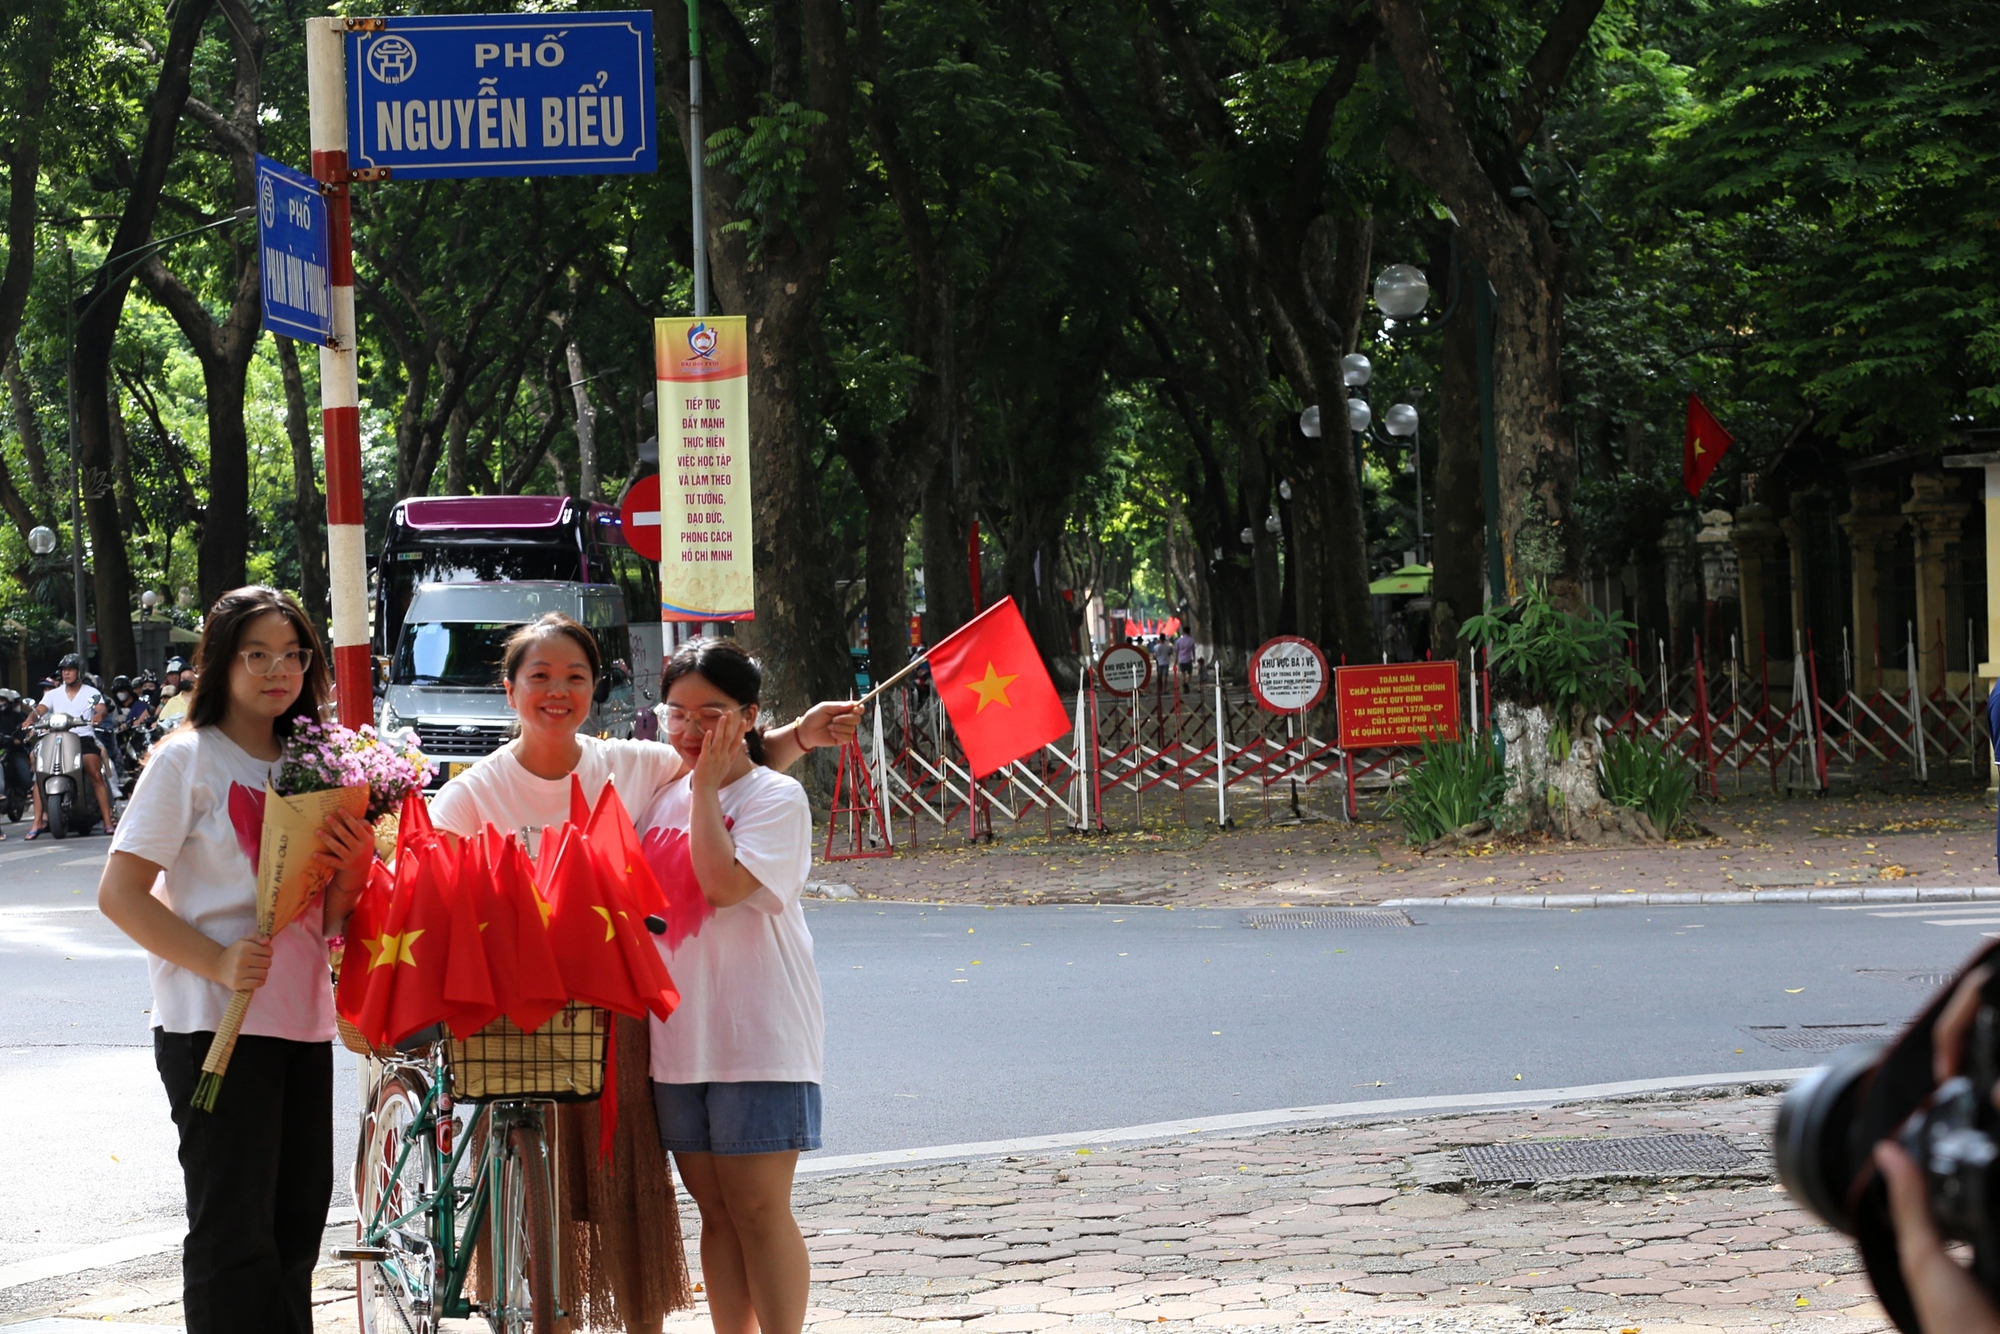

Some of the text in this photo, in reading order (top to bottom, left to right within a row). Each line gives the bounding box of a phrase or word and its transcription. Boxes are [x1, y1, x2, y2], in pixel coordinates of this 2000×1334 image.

[475, 31, 568, 68] PHỐ
[377, 71, 624, 151] NGUYỄN BIỂU
[289, 195, 311, 230] PHỐ
[266, 247, 287, 305] PHAN
[686, 396, 721, 412] TIẾP TỤC
[683, 414, 725, 431] ĐẨY MẠNH
[683, 434, 725, 450] THỰC HIỆN
[678, 453, 731, 469] VIỆC HỌC TẬP
[679, 473, 731, 486] VÀ LÀM THEO
[685, 490, 726, 505] TƯ TƯỞNG,
[688, 510, 724, 526] ĐẠO ĐỨC,
[681, 529, 732, 542] PHONG CÁCH
[695, 548, 708, 562] CHÍ
[711, 550, 732, 561] MINH
[1262, 659, 1275, 668] KHU
[1277, 657, 1289, 669] VỰC
[1306, 654, 1314, 667] VỆ
[1379, 675, 1398, 684] TOÀN
[1350, 686, 1369, 696] CHẤP
[1371, 686, 1391, 695] HÀNH
[1393, 684, 1421, 693] NGHIÊM
[1373, 695, 1423, 704] CÁC QUY ĐỊNH
[1354, 709, 1365, 717] TẠI
[1367, 708, 1385, 716] NGHỊ
[1386, 707, 1404, 715] ĐỊNH
[1372, 714, 1427, 725] CỦA CHÍNH PHỦ
[1362, 727, 1382, 735] QUẢN
[1396, 725, 1406, 734] SỬ
[460, 763, 473, 771] 29
[278, 835, 289, 858] OLD
